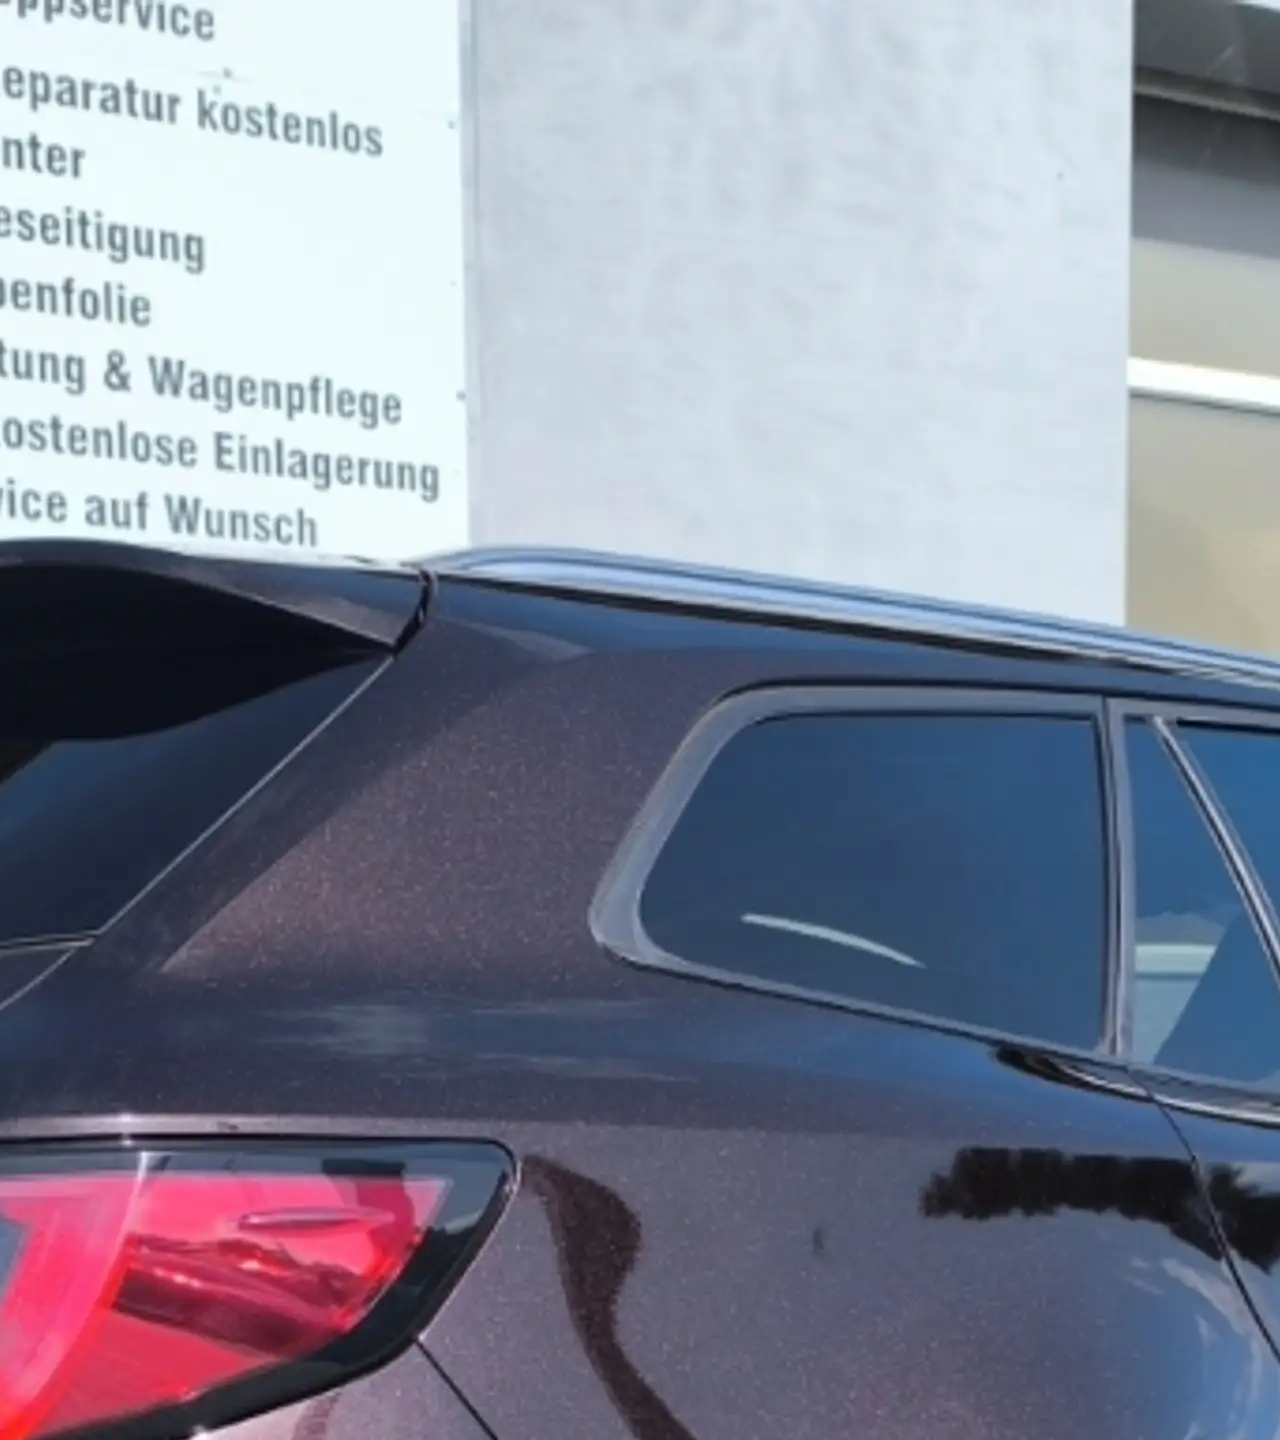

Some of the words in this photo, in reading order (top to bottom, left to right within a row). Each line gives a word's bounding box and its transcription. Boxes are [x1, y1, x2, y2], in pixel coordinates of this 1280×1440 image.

[198, 89, 382, 156] kostenlos
[104, 350, 131, 392] &
[148, 356, 402, 429] Wagenpflege
[214, 432, 439, 503] Einlagerung
[85, 492, 148, 530] auf
[164, 494, 317, 547] Wunsch
